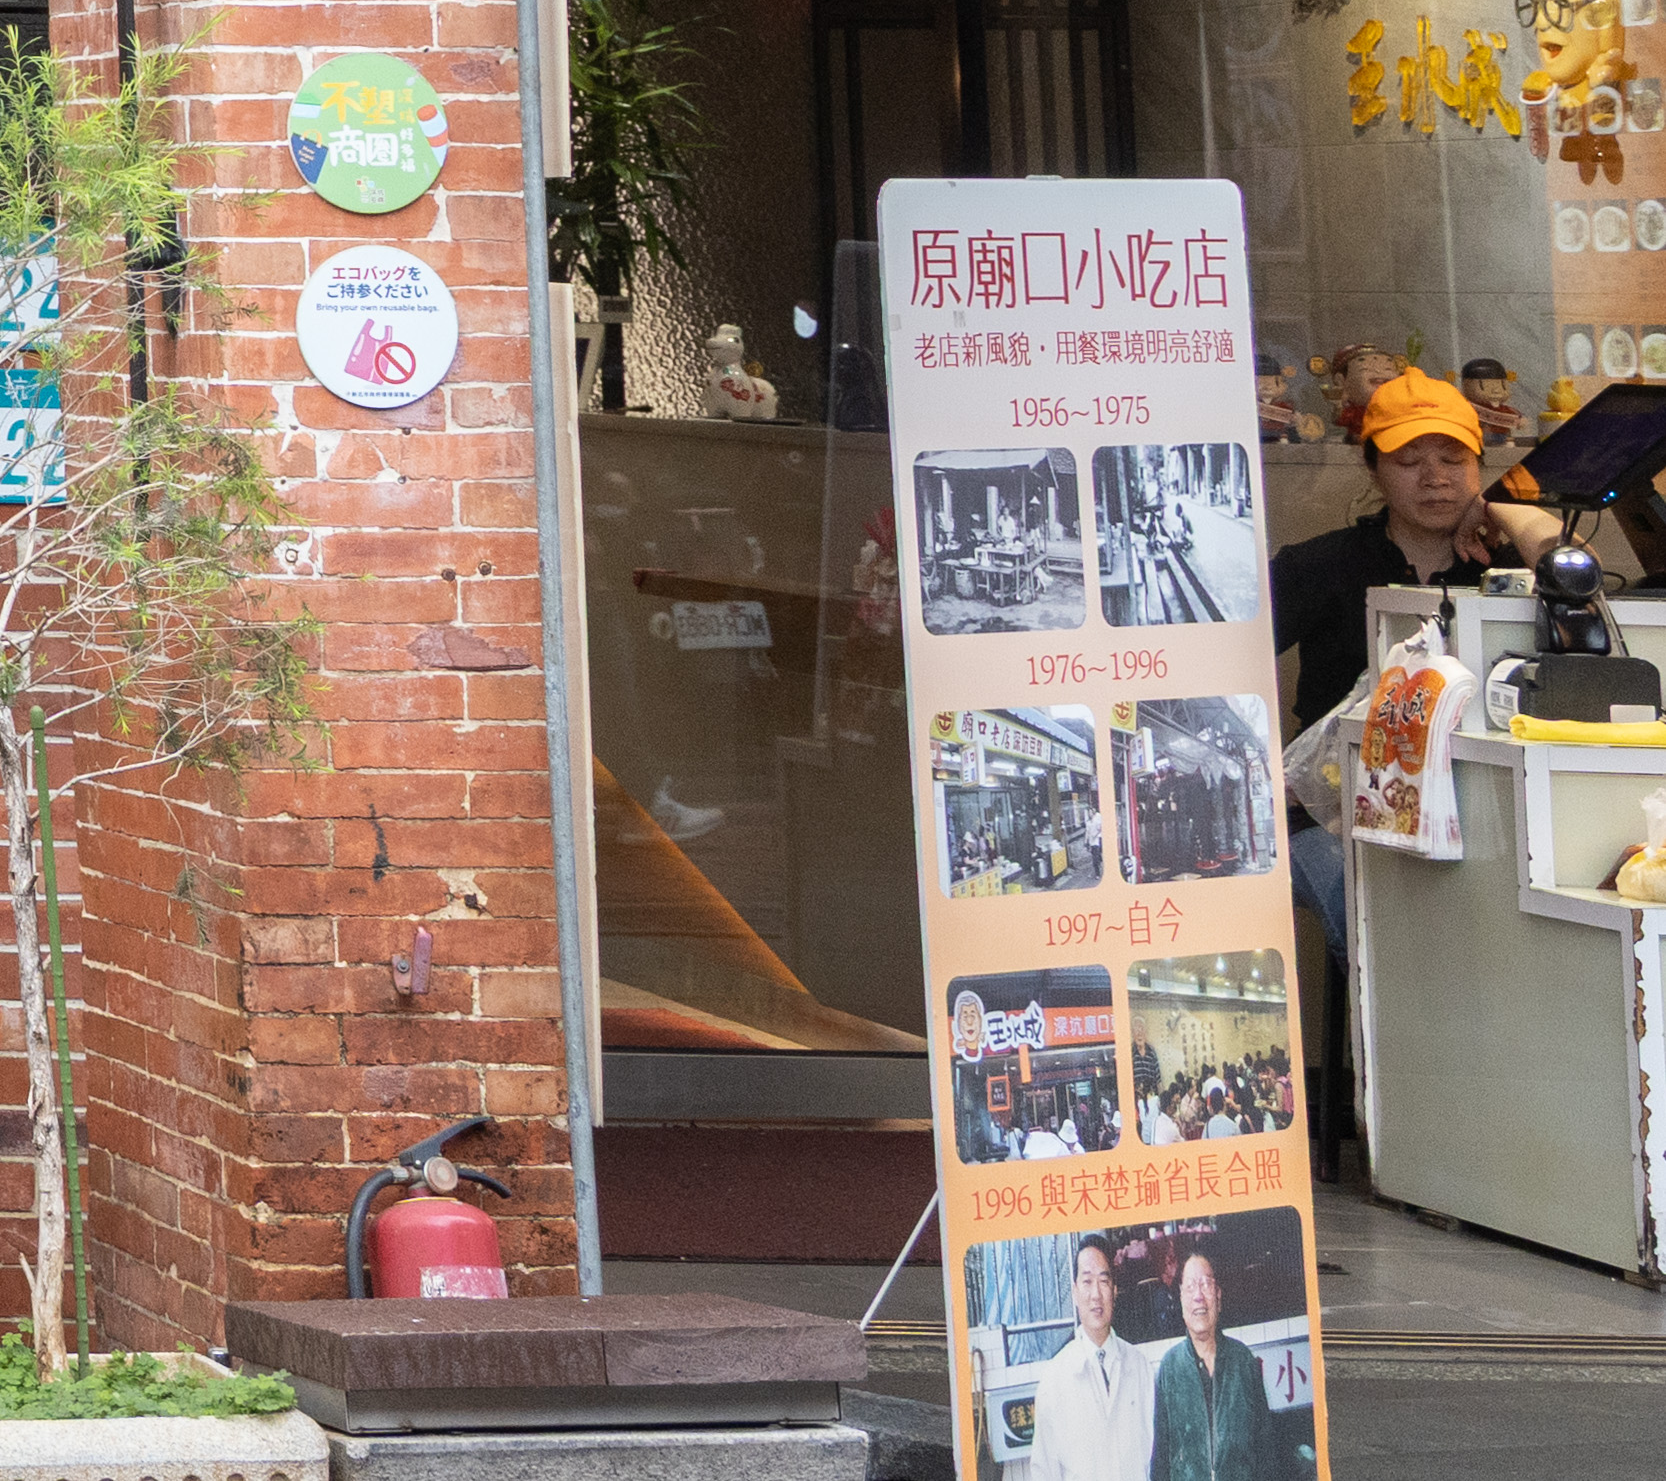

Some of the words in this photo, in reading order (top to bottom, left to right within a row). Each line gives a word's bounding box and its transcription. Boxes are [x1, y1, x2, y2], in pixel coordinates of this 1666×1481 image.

[320, 80, 397, 125] 不塑
[328, 124, 399, 167] 商圈
[399, 127, 416, 173] 好多福
[331, 265, 422, 282] エコバッグを
[910, 227, 1229, 310] 原廟口小吃店
[316, 303, 339, 313] Bring
[339, 304, 359, 313] your
[359, 304, 378, 312] own
[379, 303, 416, 312] reusable
[416, 303, 440, 314] bags.
[326, 283, 429, 299] ご持参ください
[1009, 395, 1151, 429] 1956~1975
[1025, 648, 1169, 687] 1976~1996
[1042, 897, 1185, 949] 1997~自今
[970, 1185, 1034, 1222] 1996
[1040, 1147, 1284, 1221] 與宋楚瑜省長合照
[1275, 1348, 1308, 1404] 小
